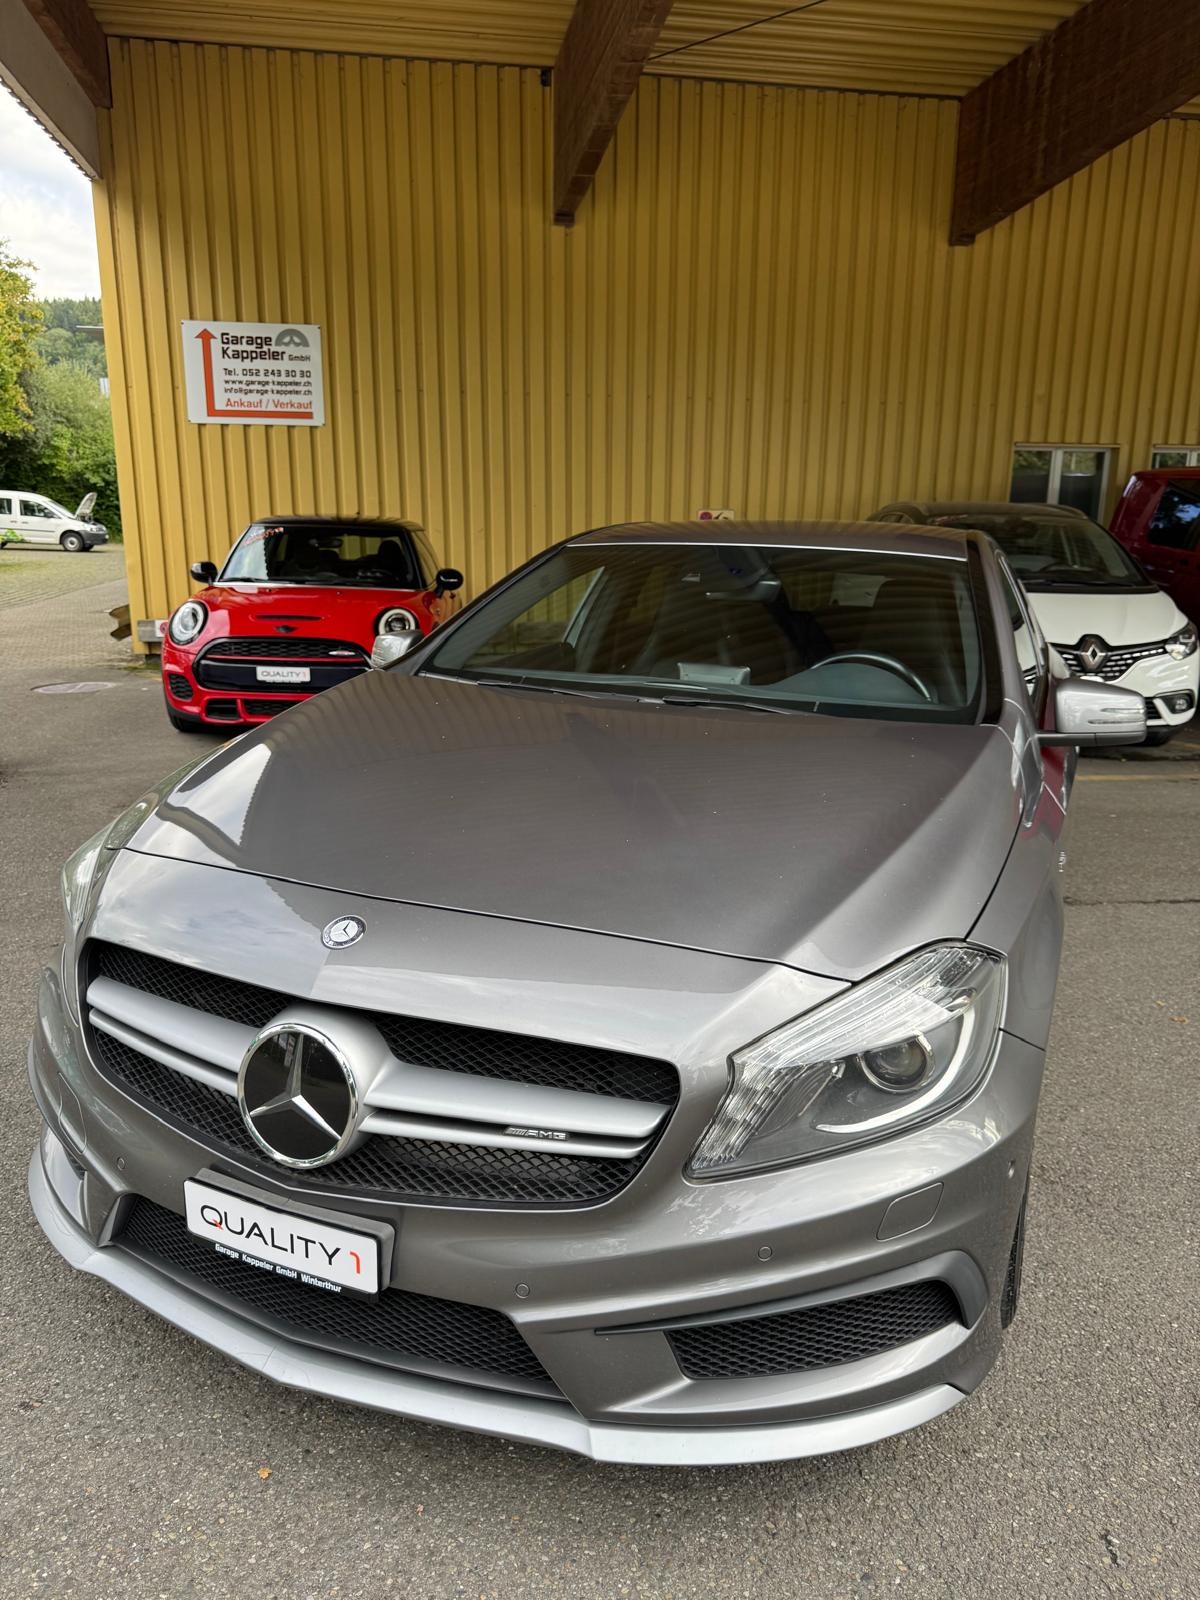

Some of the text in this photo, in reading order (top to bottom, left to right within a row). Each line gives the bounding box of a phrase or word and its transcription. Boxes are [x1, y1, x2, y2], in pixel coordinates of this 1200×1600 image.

[221, 332, 272, 349] Garage
[222, 346, 311, 362] Kappeler GmbH
[223, 368, 311, 378] Tel. 052 243 30 30
[224, 379, 312, 387] www.garage-kappeler.ch
[224, 387, 312, 396] info@garage-kappeler.ch
[225, 398, 262, 408] Ankauf
[272, 399, 312, 409] Verkauf
[527, 1129, 566, 1140] AMG
[215, 1243, 342, 1293] Garage Kappeler GmbH Winterthur
